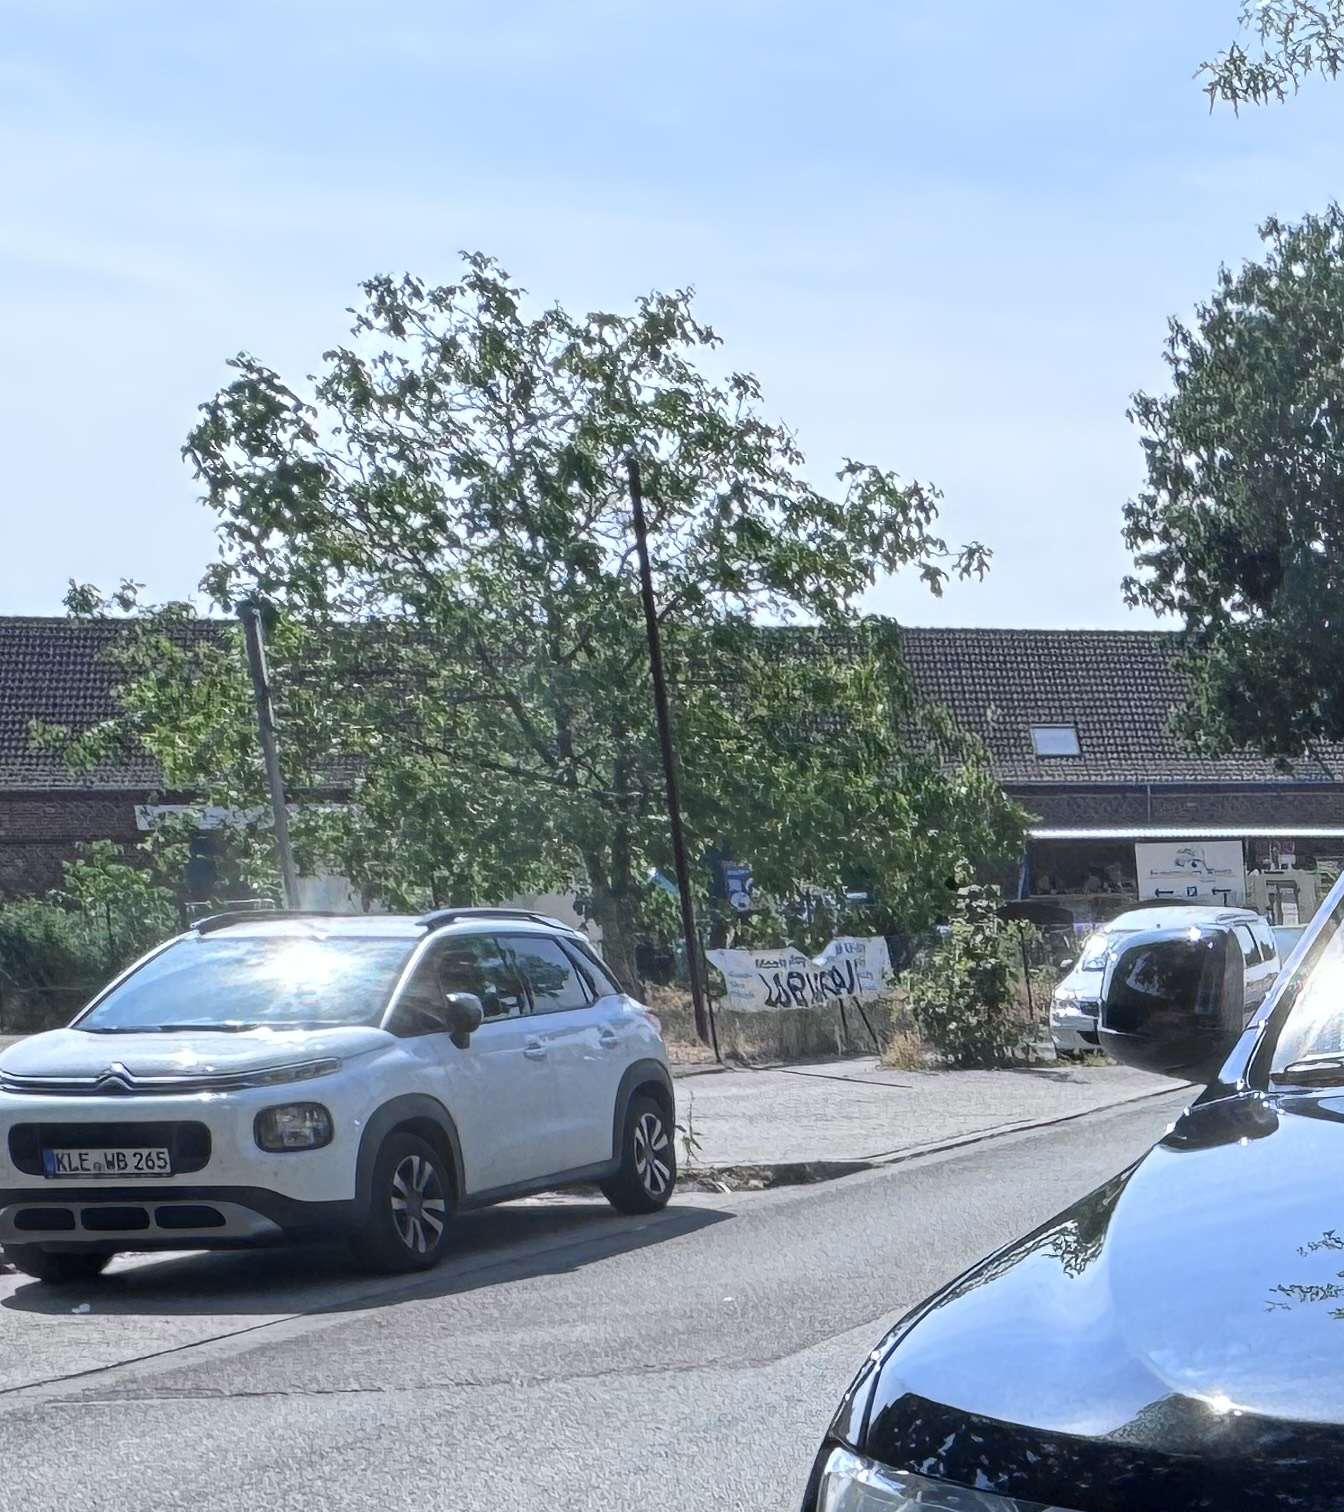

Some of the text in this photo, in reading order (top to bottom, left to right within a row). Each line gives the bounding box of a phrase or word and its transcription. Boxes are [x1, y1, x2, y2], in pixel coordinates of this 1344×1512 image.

[55, 1151, 168, 1172] KLE WB 265
